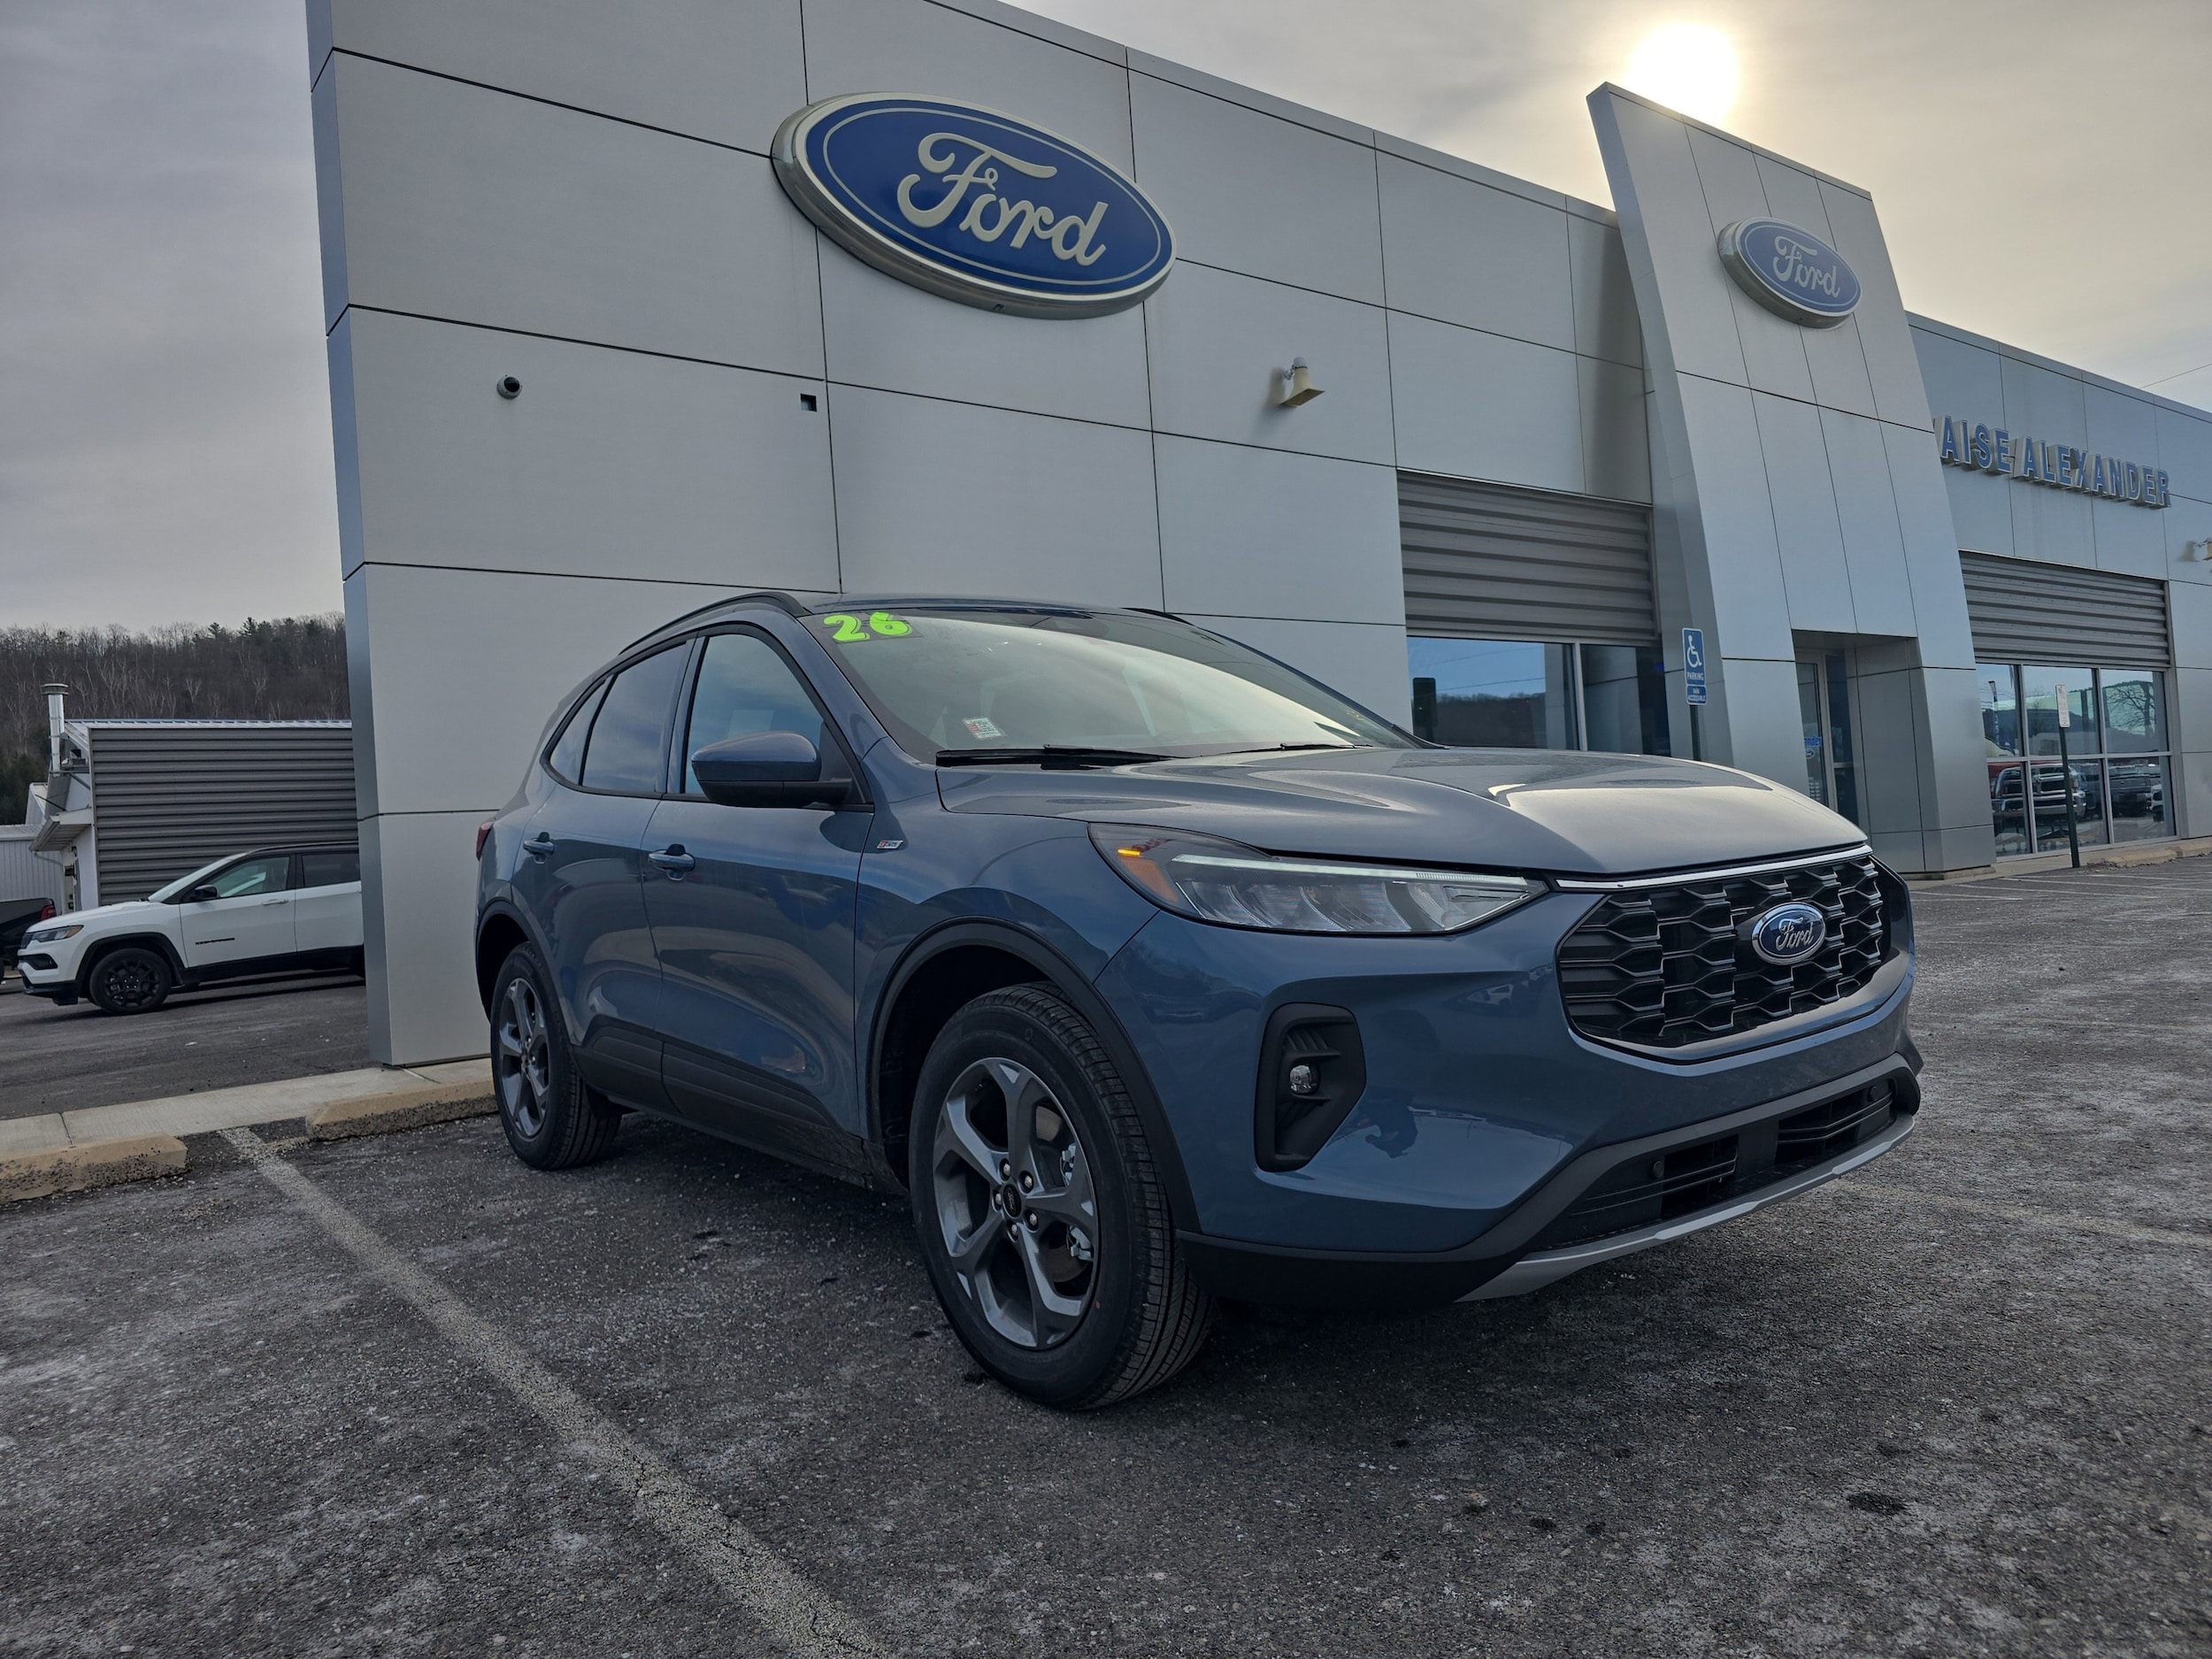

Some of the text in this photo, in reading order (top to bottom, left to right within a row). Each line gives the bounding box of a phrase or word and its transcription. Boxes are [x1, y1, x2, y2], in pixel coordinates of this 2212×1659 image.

[896, 132, 1109, 267] Ford
[1772, 235, 1841, 298] Ford
[2021, 435, 2171, 508] ALEXANDER
[823, 611, 913, 642] 26
[1775, 917, 1814, 951] Ford
